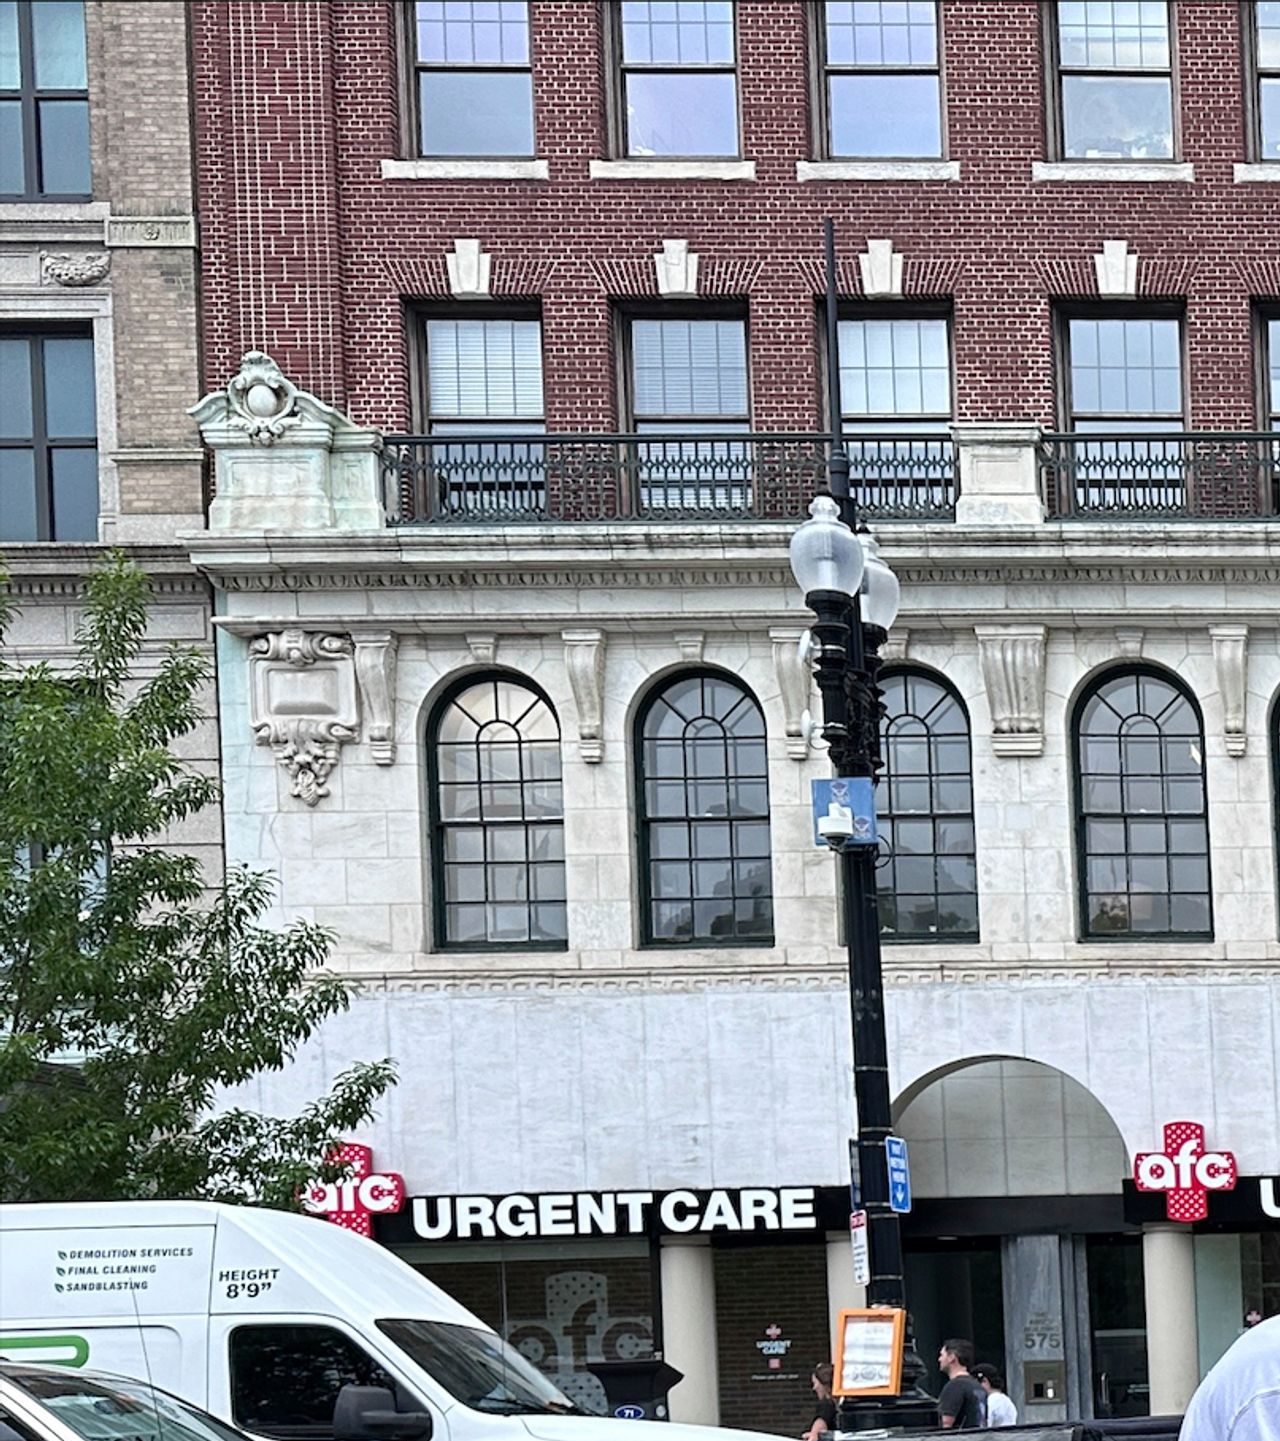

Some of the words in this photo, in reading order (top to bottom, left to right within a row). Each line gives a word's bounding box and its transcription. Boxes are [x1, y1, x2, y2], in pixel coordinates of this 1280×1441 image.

[1138, 1139, 1231, 1189] afc
[411, 1192, 659, 1240] URGENT
[659, 1187, 818, 1233] CARE
[69, 1250, 137, 1259] DEMOLITION
[140, 1247, 194, 1257] SERVICES
[68, 1266, 99, 1275] FINAL
[102, 1264, 157, 1274] CLEANING
[218, 1268, 281, 1282] HEIGHT
[66, 1281, 148, 1291] SANDBLASTING
[1024, 1333, 1061, 1349] 575
